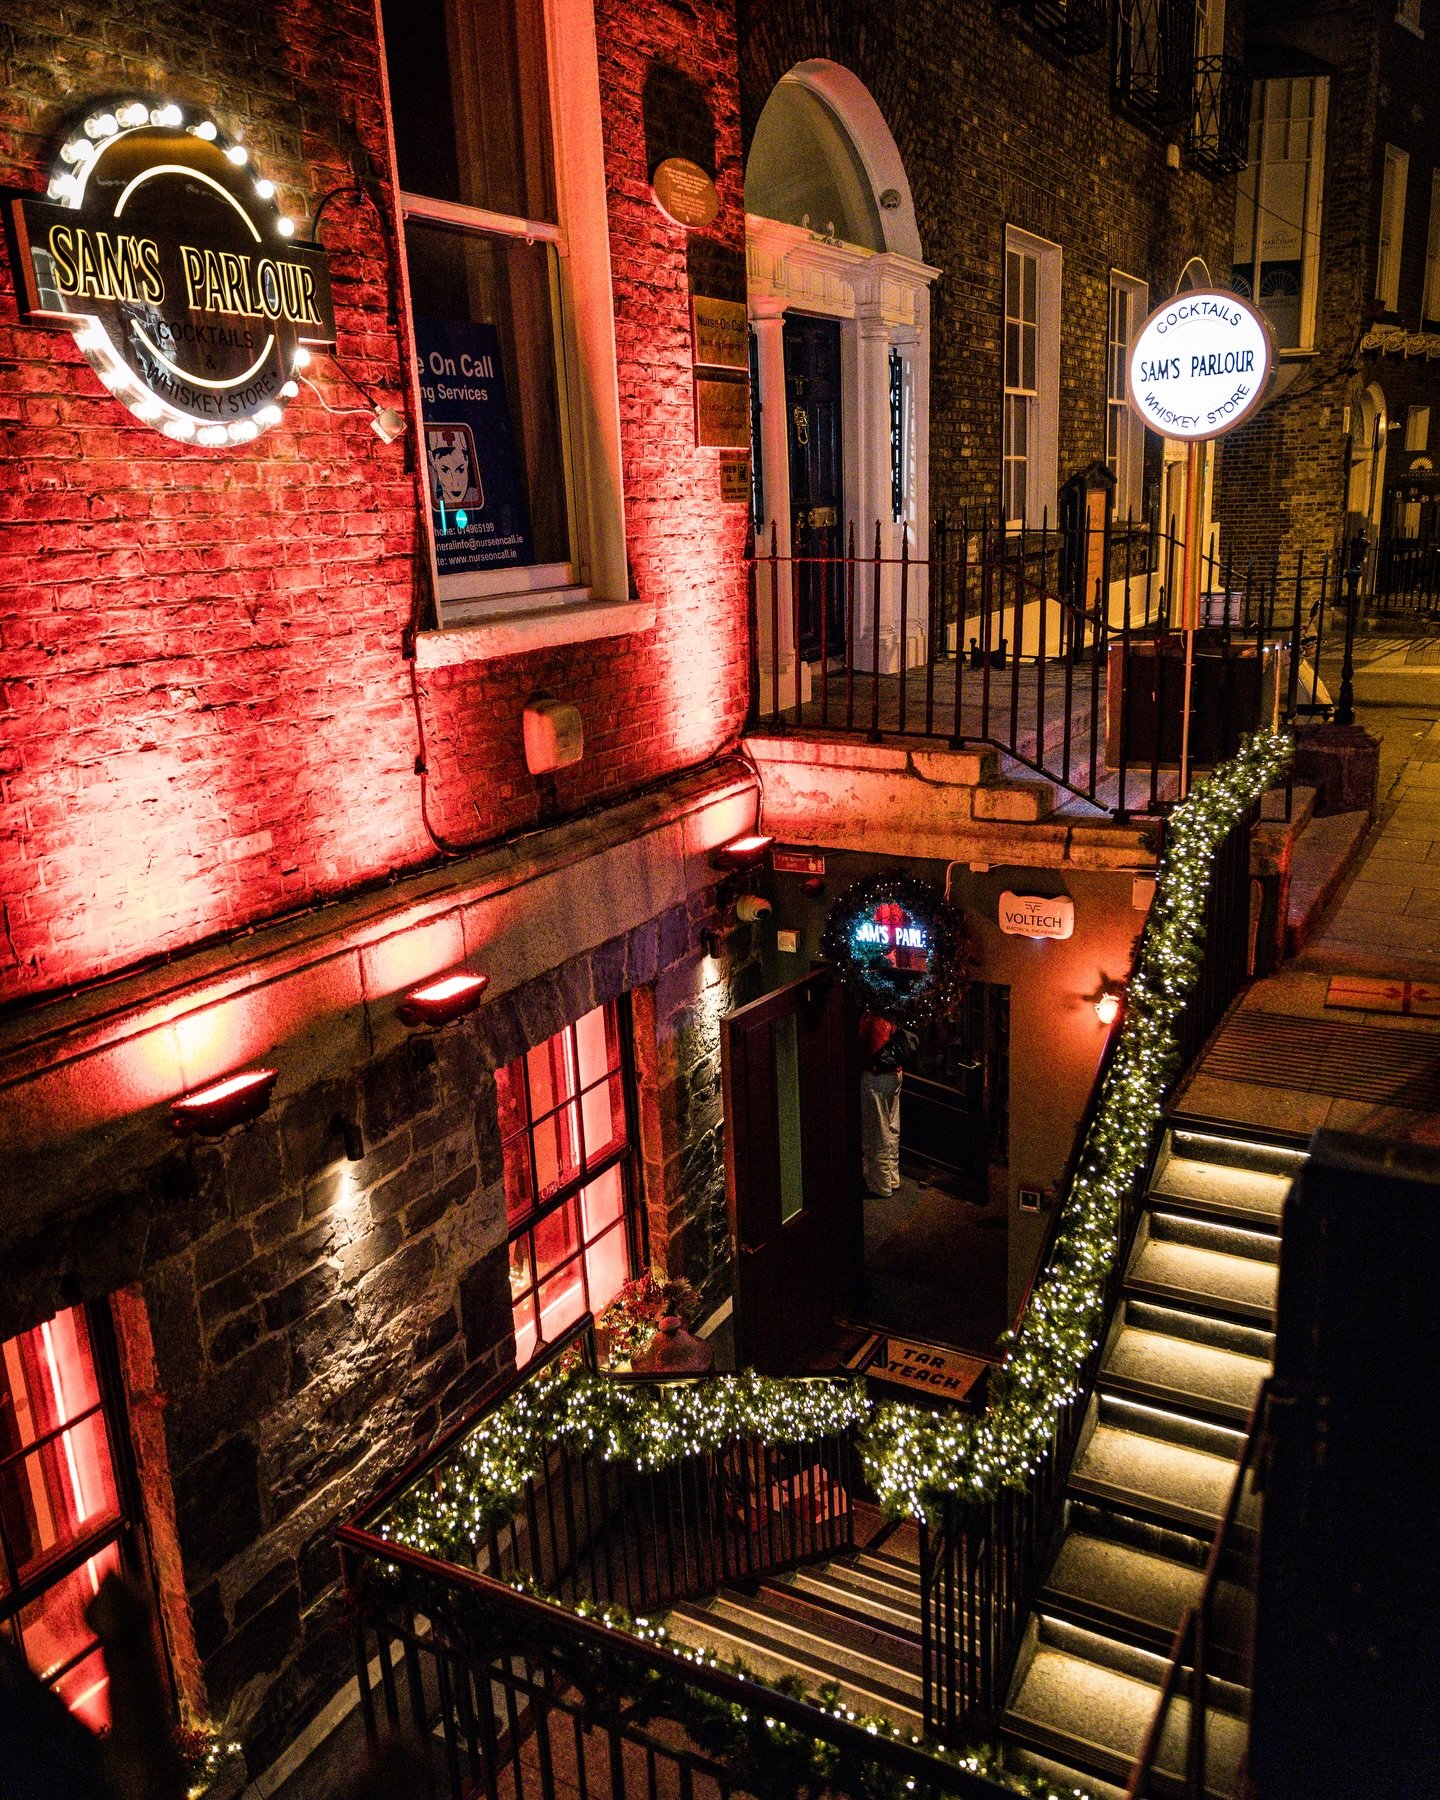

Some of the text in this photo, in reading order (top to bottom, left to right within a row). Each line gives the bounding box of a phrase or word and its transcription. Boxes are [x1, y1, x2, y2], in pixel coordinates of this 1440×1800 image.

[50, 225, 322, 325] SAM'S PARLOUR
[697, 313, 745, 332] Nurse On Call
[1156, 302, 1242, 334] COCKTAILS
[157, 320, 254, 349] COCKTAILS
[206, 354, 216, 370] &
[429, 351, 457, 376] On
[460, 353, 494, 378] Call
[1140, 350, 1254, 383] SAM'S PARLOUR
[146, 363, 275, 414] WHISKEY STORE
[437, 383, 488, 401] Services
[1144, 384, 1251, 428] WHISKEY STORE
[448, 549, 517, 565] www.nurseoncall.ie
[1005, 912, 1062, 928] VOLTECH
[902, 1348, 945, 1369] TAR
